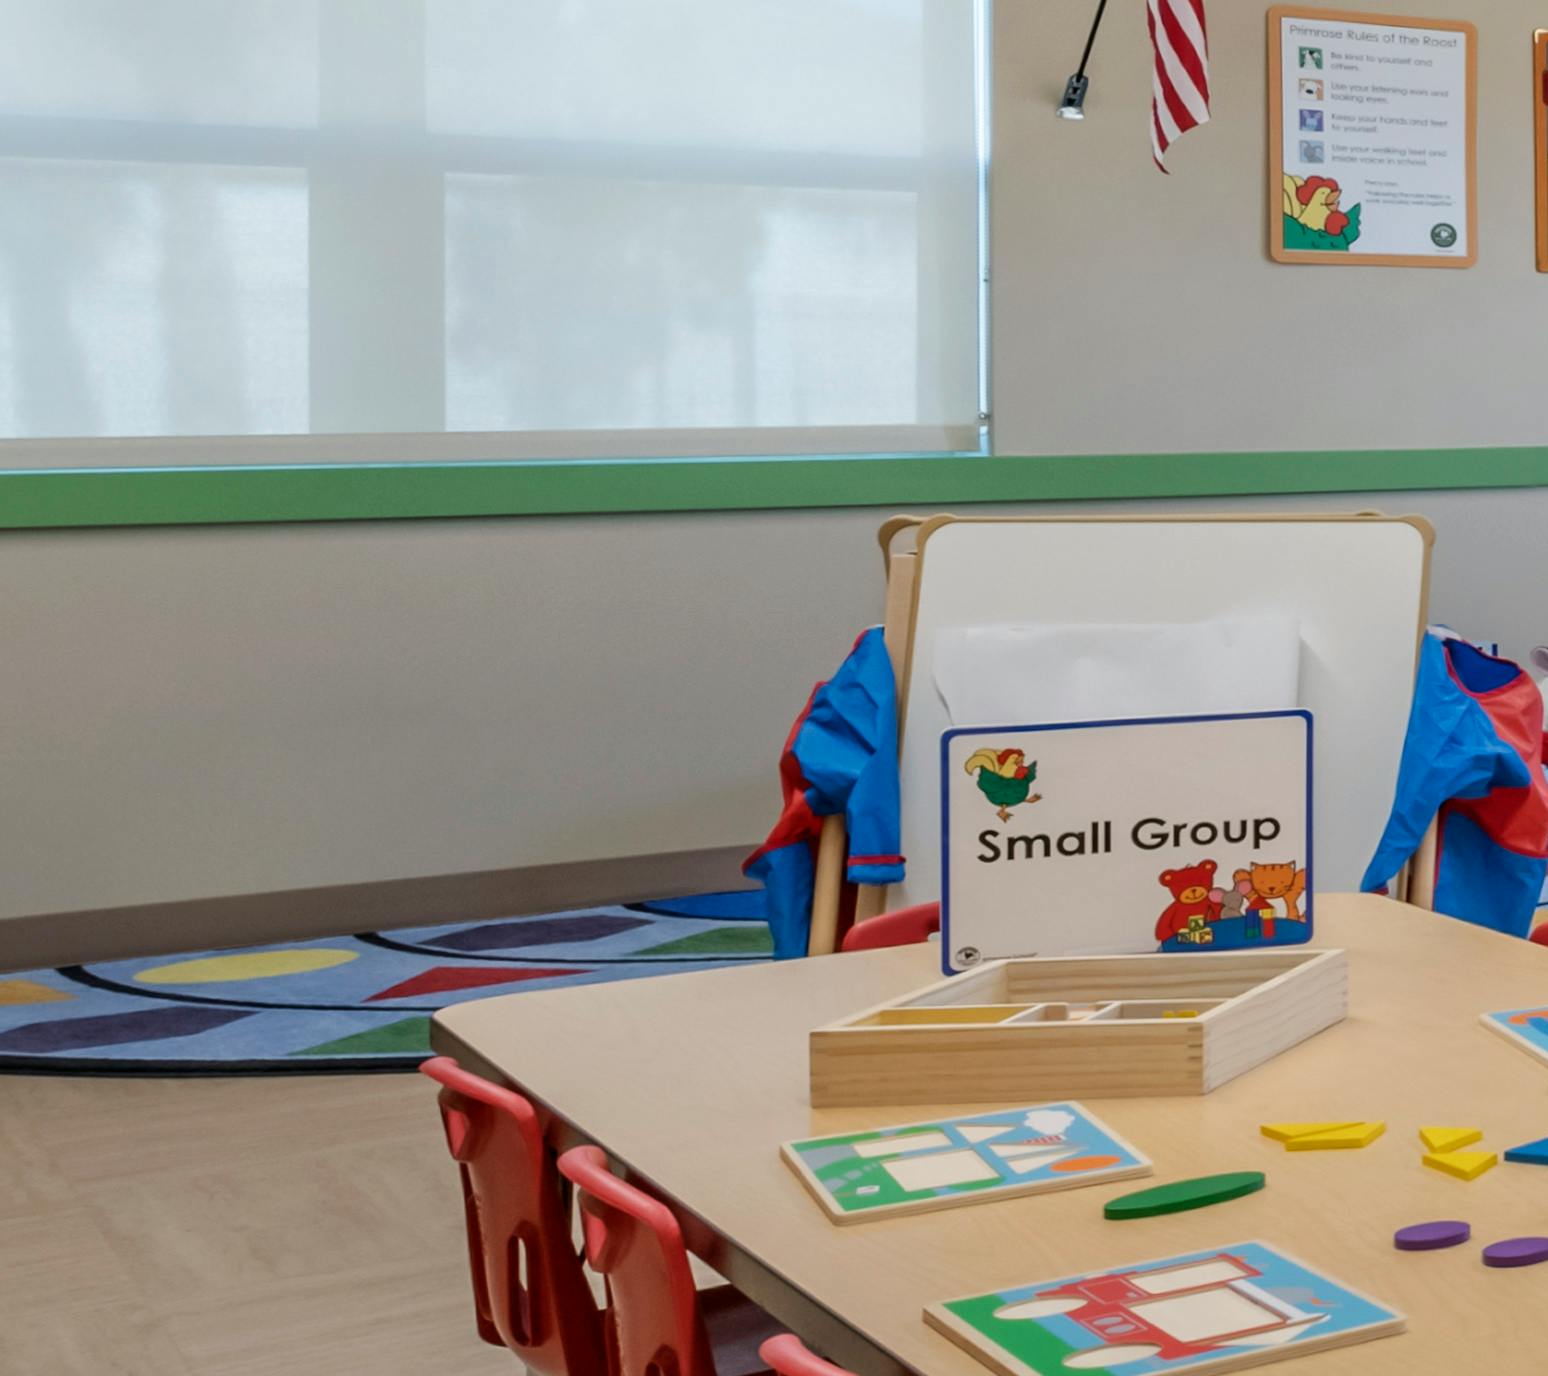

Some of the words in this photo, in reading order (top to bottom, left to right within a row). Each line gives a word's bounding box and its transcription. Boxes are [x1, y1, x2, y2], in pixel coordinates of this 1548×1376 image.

[1289, 24, 1343, 40] Primrose
[1347, 27, 1379, 43] Rules
[1382, 31, 1395, 44] of
[1399, 32, 1420, 46] the
[1423, 35, 1458, 48] Roost
[977, 820, 1112, 864] Small
[1130, 816, 1282, 851] Group
